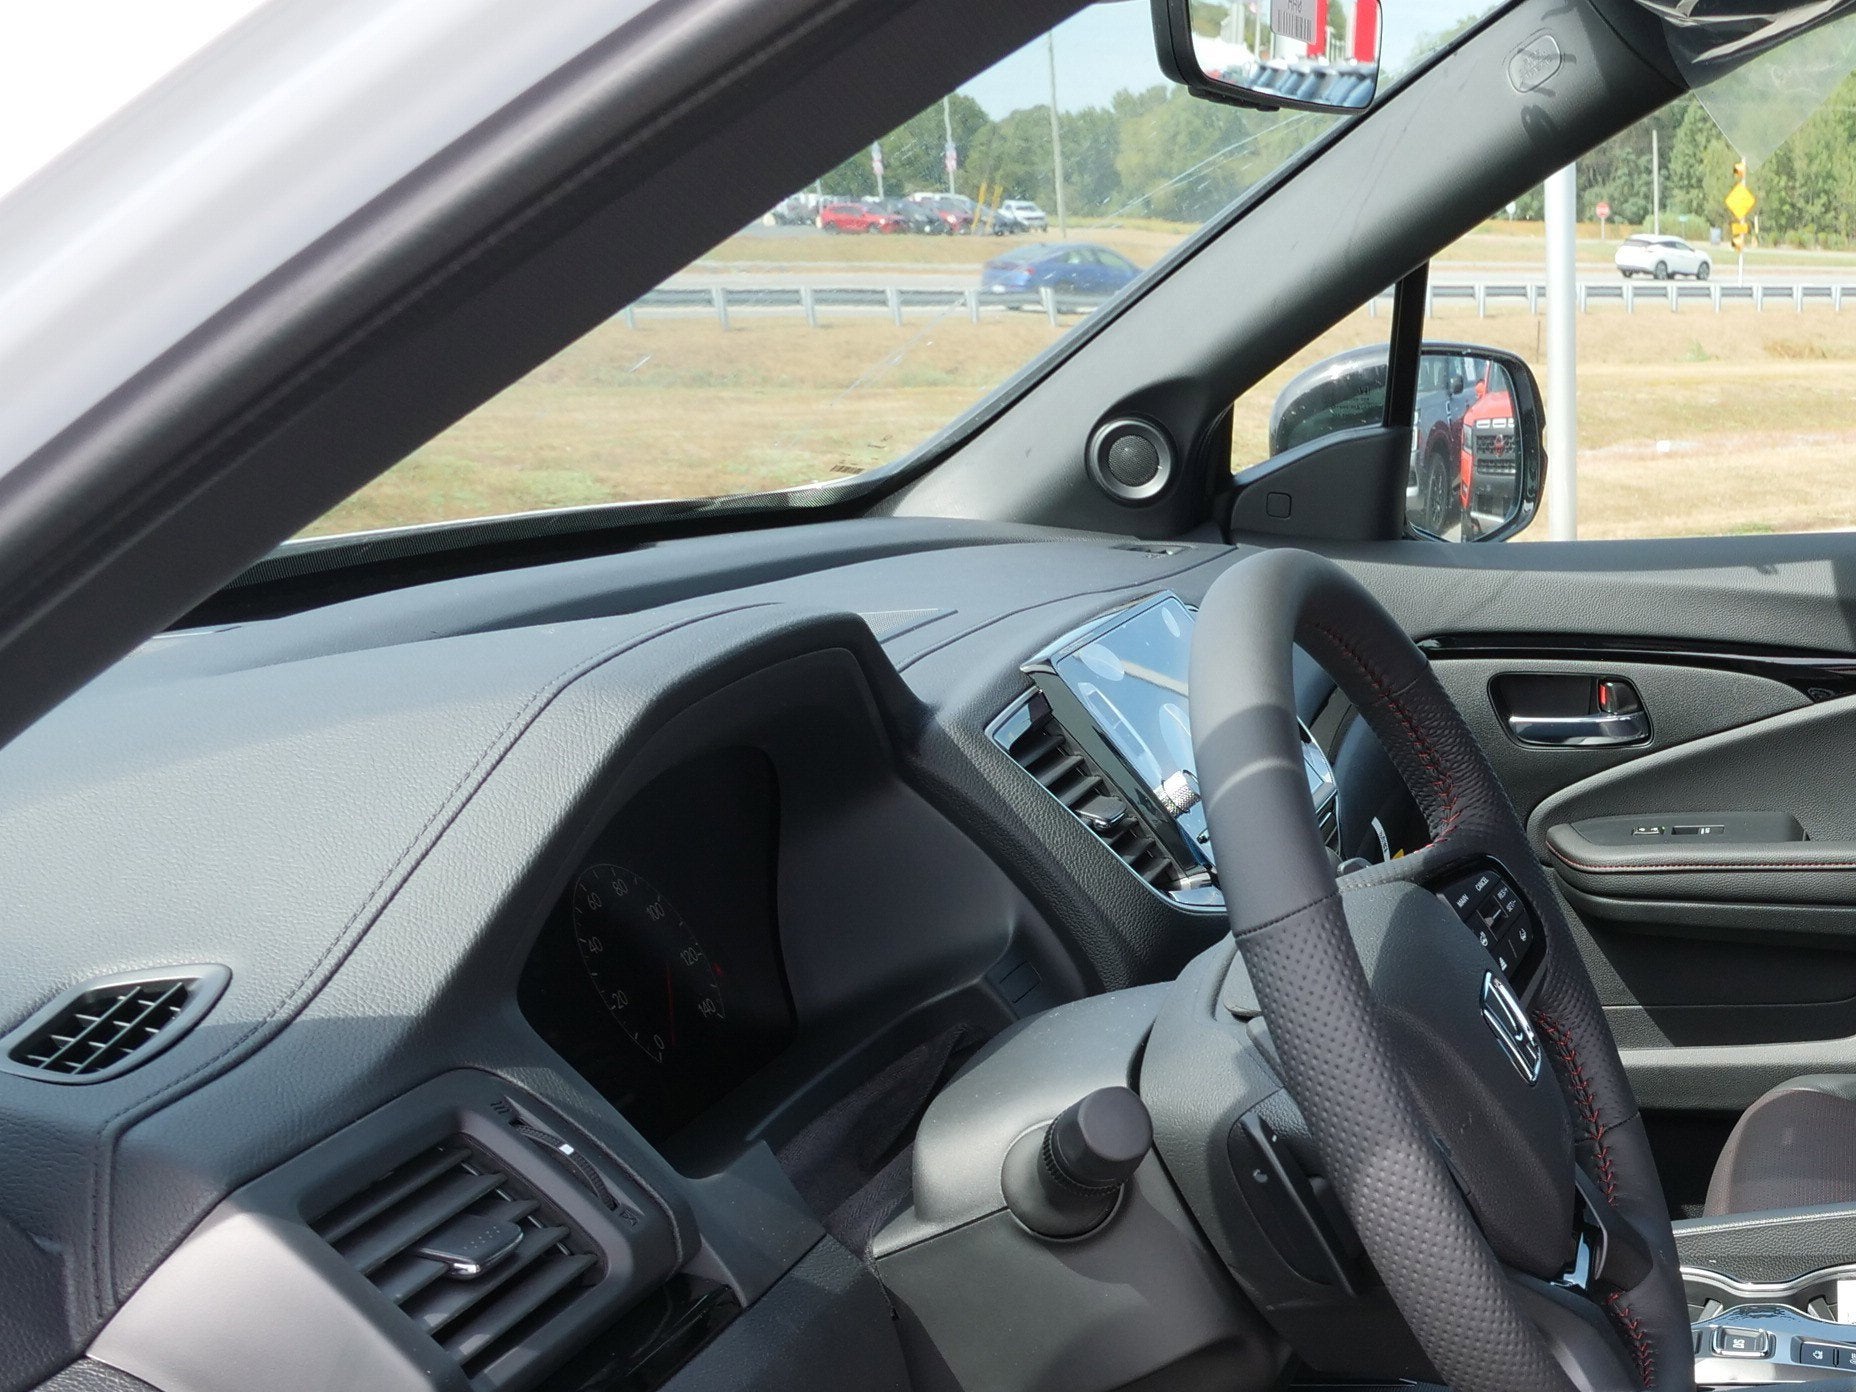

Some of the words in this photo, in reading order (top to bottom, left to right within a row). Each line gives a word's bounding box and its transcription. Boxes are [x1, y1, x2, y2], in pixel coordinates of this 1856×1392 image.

[612, 879, 629, 896] 80
[587, 894, 603, 910] 60
[646, 901, 665, 921] 100
[588, 937, 603, 953] 40
[680, 947, 699, 966] 120
[612, 990, 629, 1010] 20
[698, 998, 716, 1018] 140
[653, 1034, 665, 1050] 0
